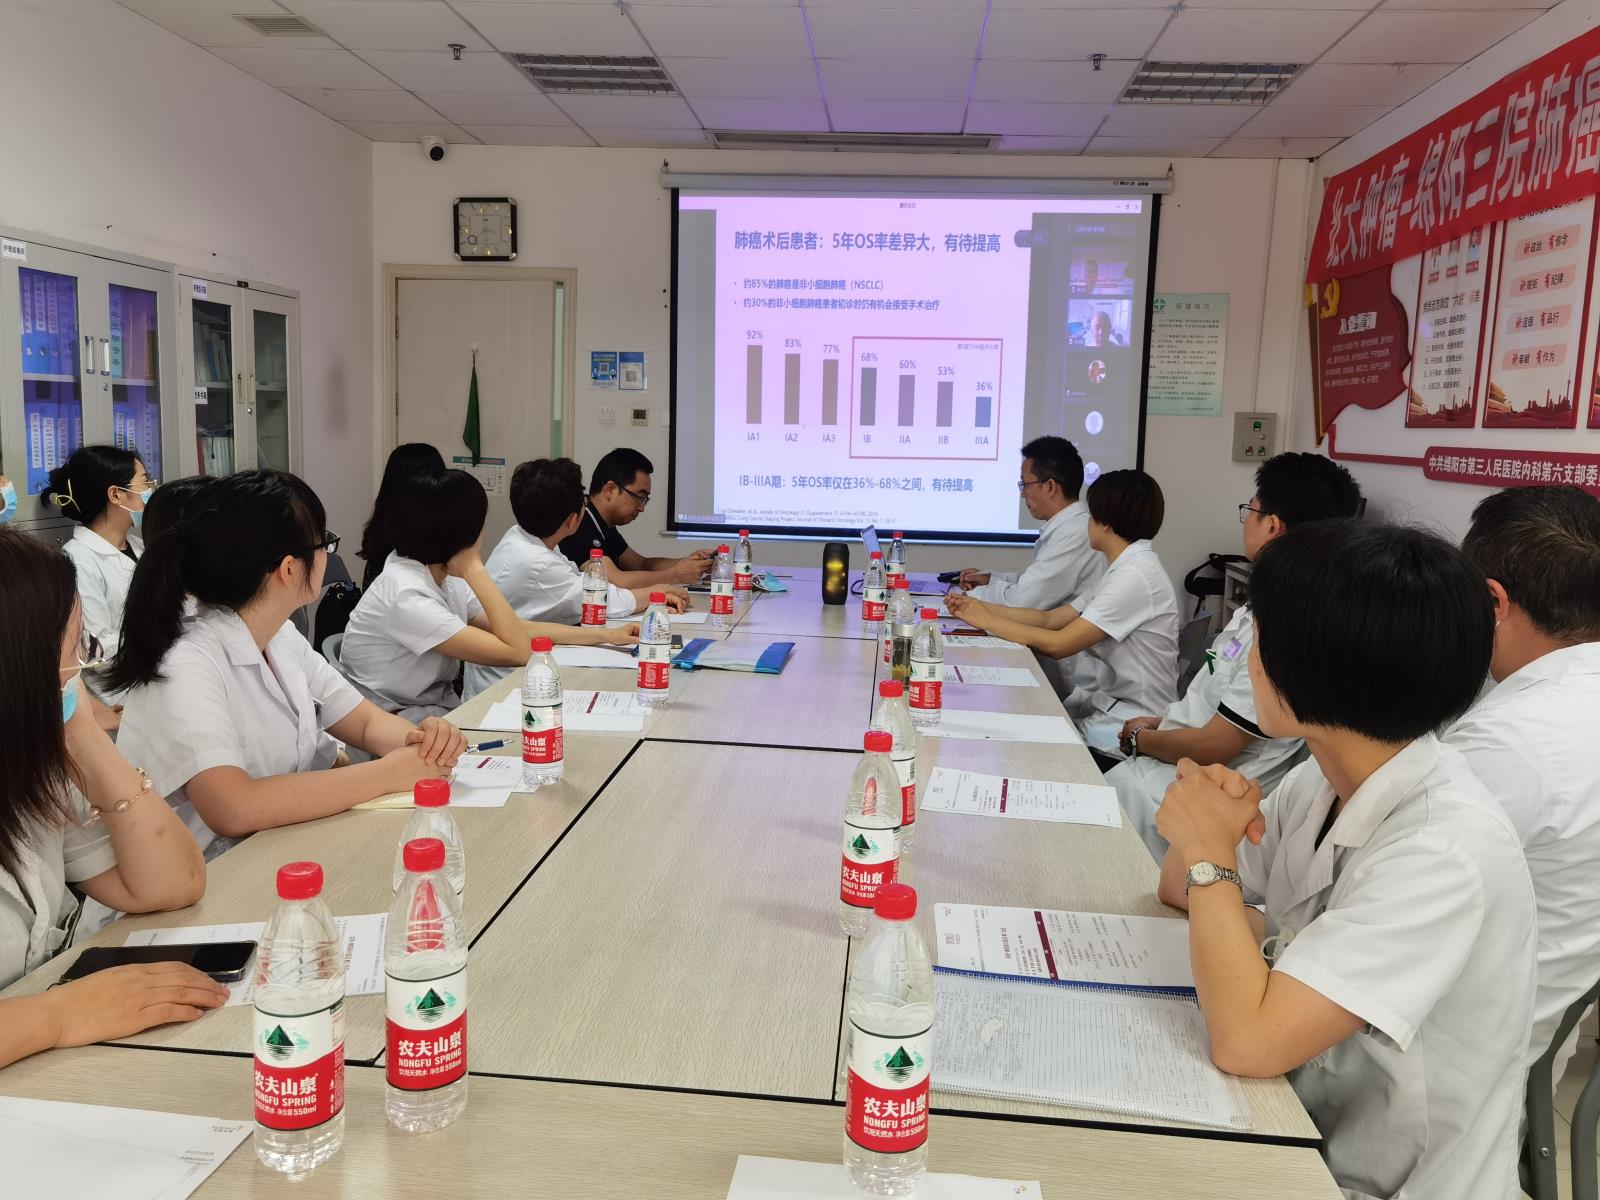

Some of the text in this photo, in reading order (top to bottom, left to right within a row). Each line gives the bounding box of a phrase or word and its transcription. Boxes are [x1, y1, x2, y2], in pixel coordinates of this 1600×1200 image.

[746, 330, 764, 340] 92%
[784, 338, 802, 348] 83%
[823, 344, 840, 354] 77%
[861, 352, 878, 362] 68%
[899, 360, 916, 369] 60%
[937, 366, 955, 376] 53%
[976, 381, 993, 391] 36%
[1429, 455, 1600, 486] 中共绵阳市第三人民医院内科第六支部委
[398, 1030, 462, 1058] 农夫山泉
[398, 1047, 462, 1068] NONGFU SPRING
[254, 1069, 318, 1096] 农夫山泉
[281, 1094, 317, 1107] SPRING
[863, 1093, 926, 1118] 农夫山泉
[863, 1111, 926, 1129] NONGFU SPRING
